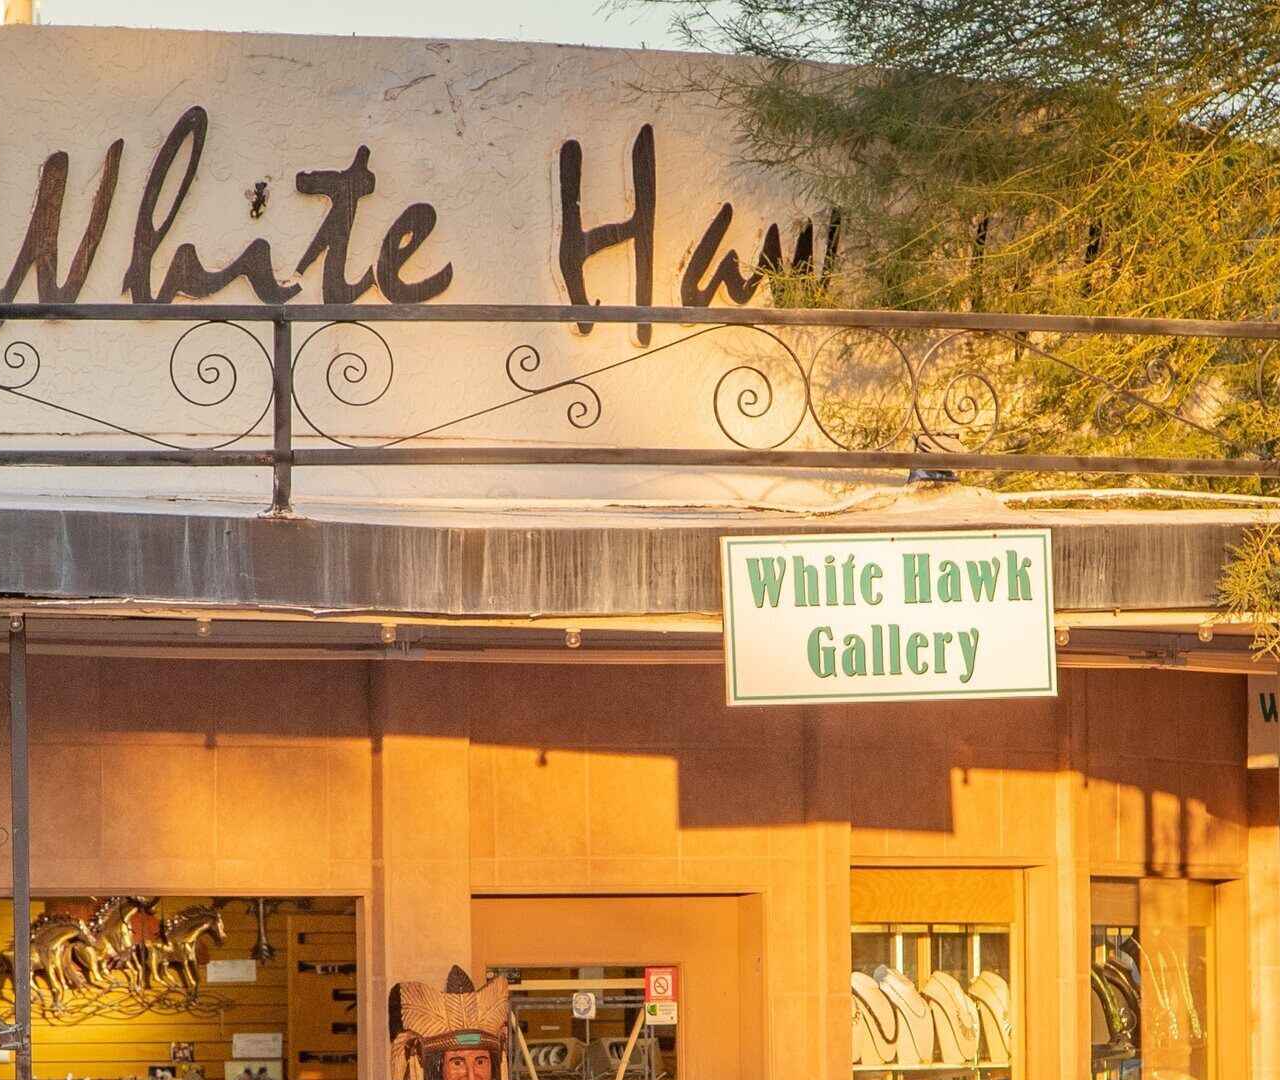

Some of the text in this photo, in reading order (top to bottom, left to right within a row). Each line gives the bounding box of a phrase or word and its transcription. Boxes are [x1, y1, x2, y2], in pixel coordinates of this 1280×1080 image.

[558, 122, 842, 348] Haw
[745, 549, 1033, 609] White Hawk
[806, 623, 980, 683] Gallery
